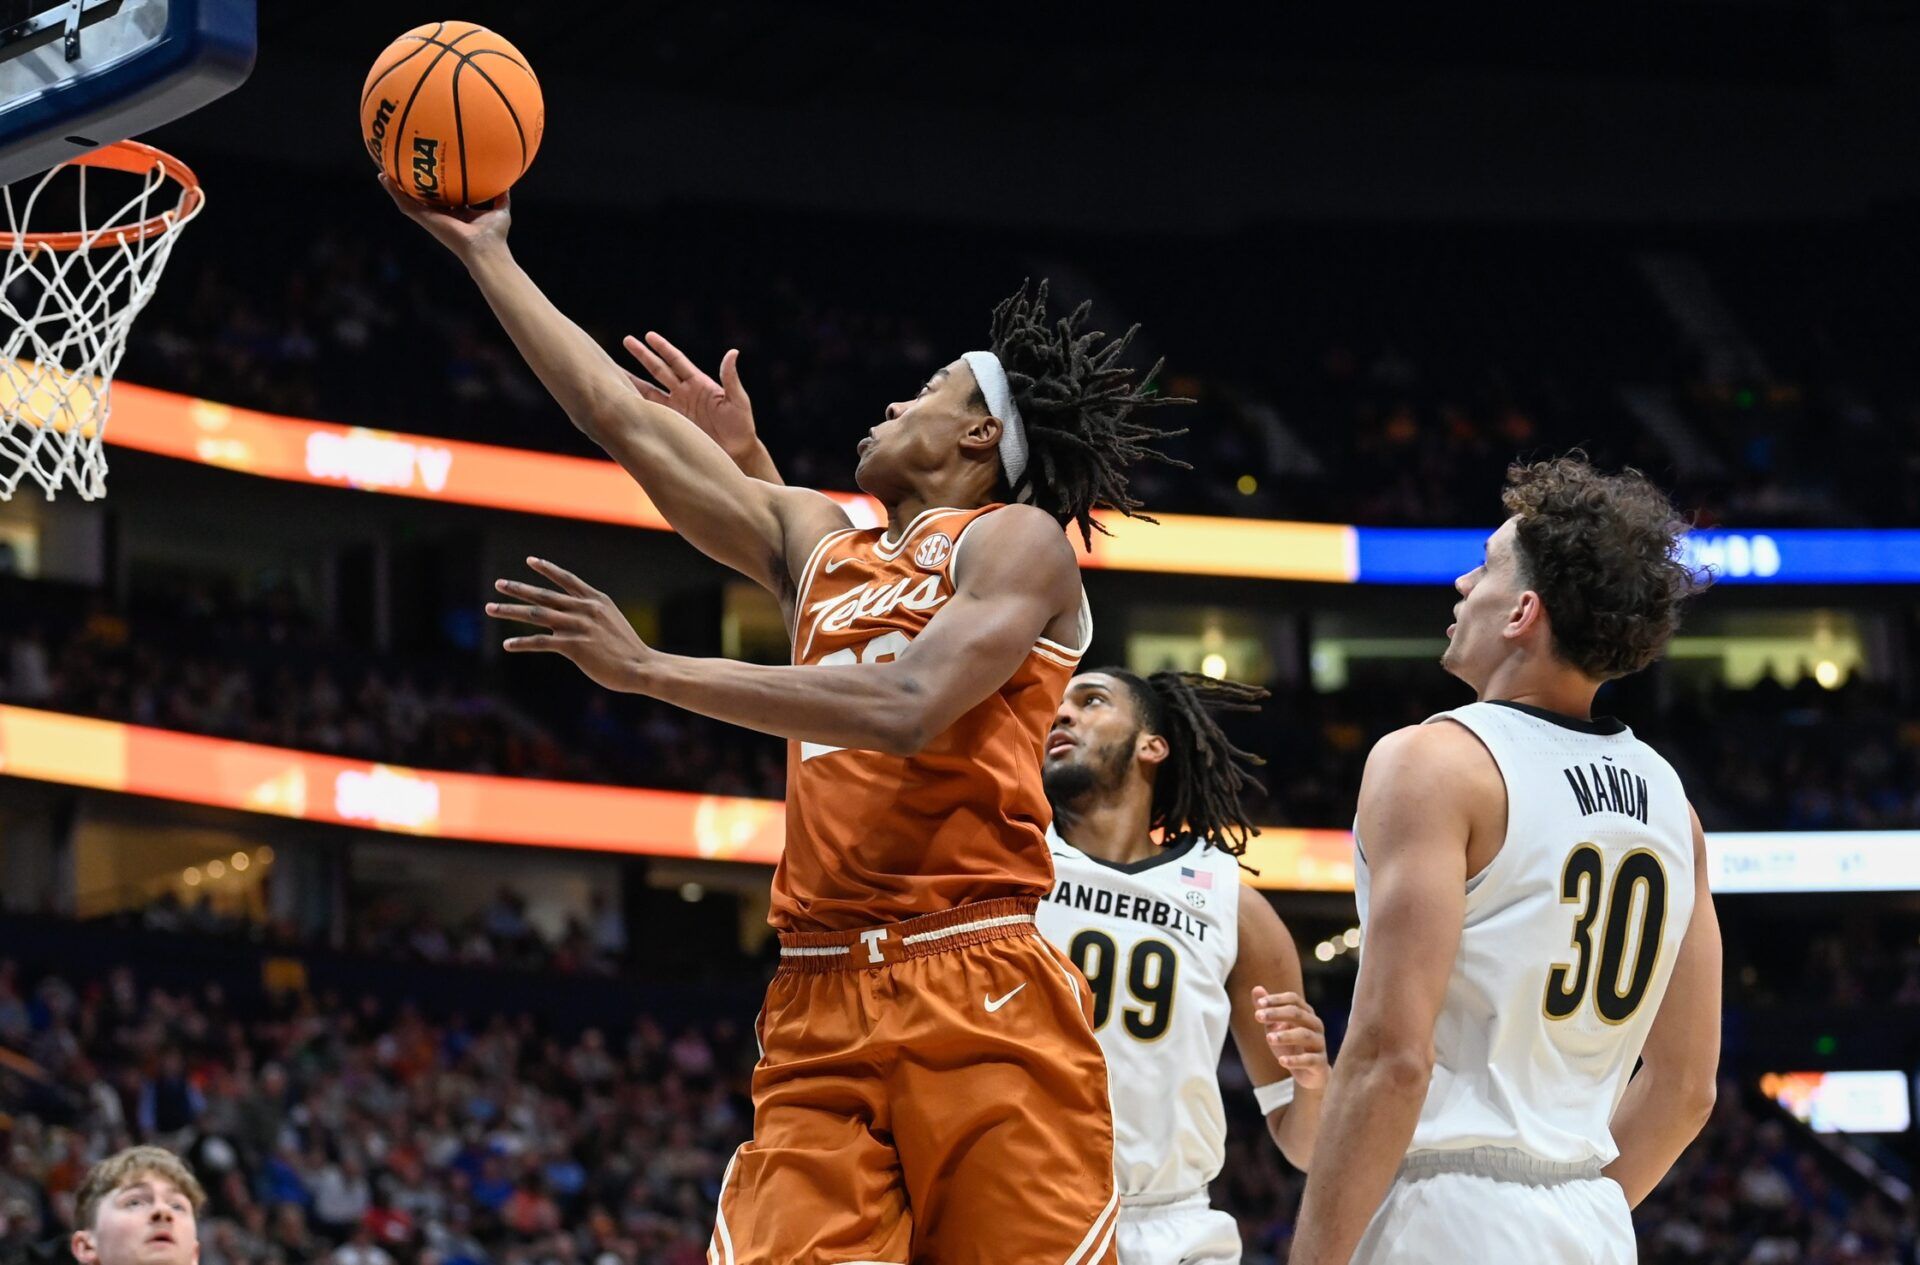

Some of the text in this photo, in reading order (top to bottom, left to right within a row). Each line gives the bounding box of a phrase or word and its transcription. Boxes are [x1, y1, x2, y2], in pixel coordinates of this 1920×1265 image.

[368, 97, 397, 160] son
[918, 536, 951, 567] SEC
[802, 575, 948, 660] Texas
[1563, 756, 1649, 825] MAÑON
[860, 928, 888, 964] T
[1542, 841, 1668, 1026] 30
[1068, 927, 1179, 1044] 99
